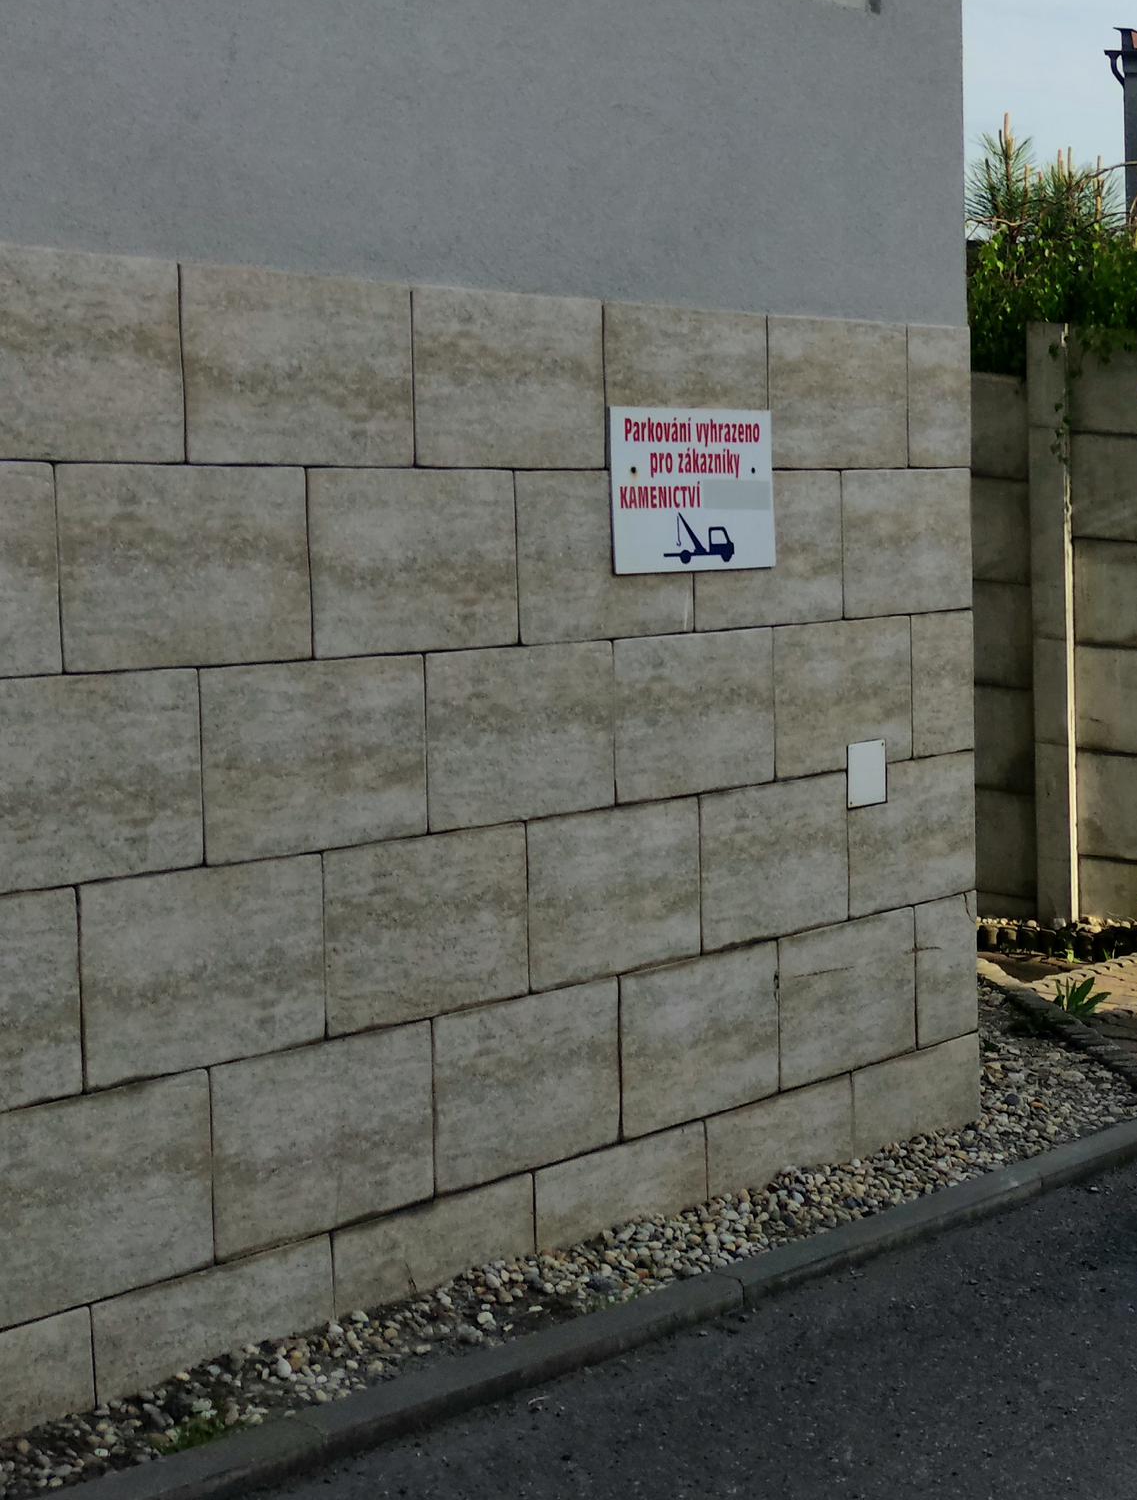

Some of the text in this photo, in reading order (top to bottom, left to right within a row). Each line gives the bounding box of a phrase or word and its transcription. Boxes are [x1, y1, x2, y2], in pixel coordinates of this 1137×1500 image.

[624, 417, 760, 447] Parkování vyhrazeno
[650, 447, 740, 478] pro zákazníky
[620, 481, 702, 509] KAMENICTVÍ
